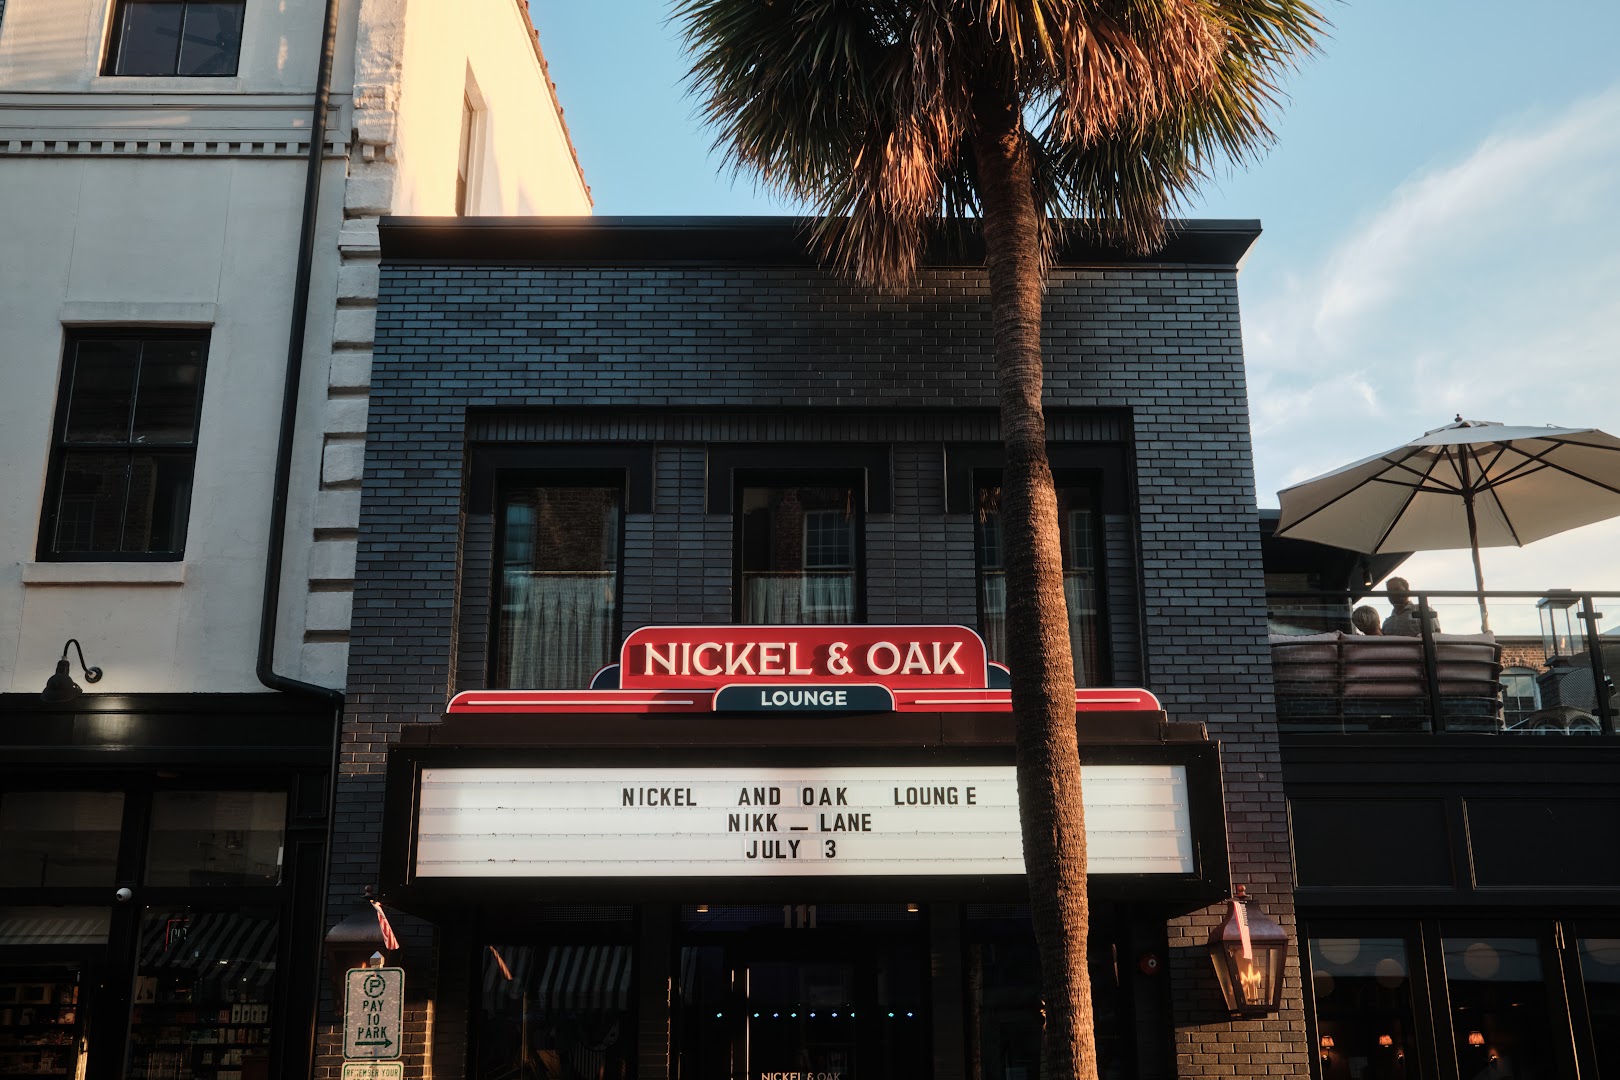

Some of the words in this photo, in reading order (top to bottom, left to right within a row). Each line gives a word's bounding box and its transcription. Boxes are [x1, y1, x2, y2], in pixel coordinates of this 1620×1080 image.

[643, 642, 813, 676] NICKEL
[826, 641, 853, 675] &
[866, 641, 965, 675] OAK
[760, 690, 847, 706] LOUNGE
[622, 788, 697, 806] NICKEL
[738, 787, 781, 806] AND
[802, 787, 848, 805] OAK
[894, 787, 976, 805] LOUNGE
[728, 814, 778, 832] NIKK
[820, 813, 872, 832] LANE
[746, 840, 800, 859] JULY
[825, 840, 836, 859] 3
[783, 904, 817, 928] 111
[369, 979, 381, 993] P
[363, 1000, 385, 1012] PAY
[367, 1014, 380, 1026] TO
[357, 1026, 387, 1040] PARK
[382, 1068, 399, 1077] YOUR
[817, 1072, 841, 1080] OAK
